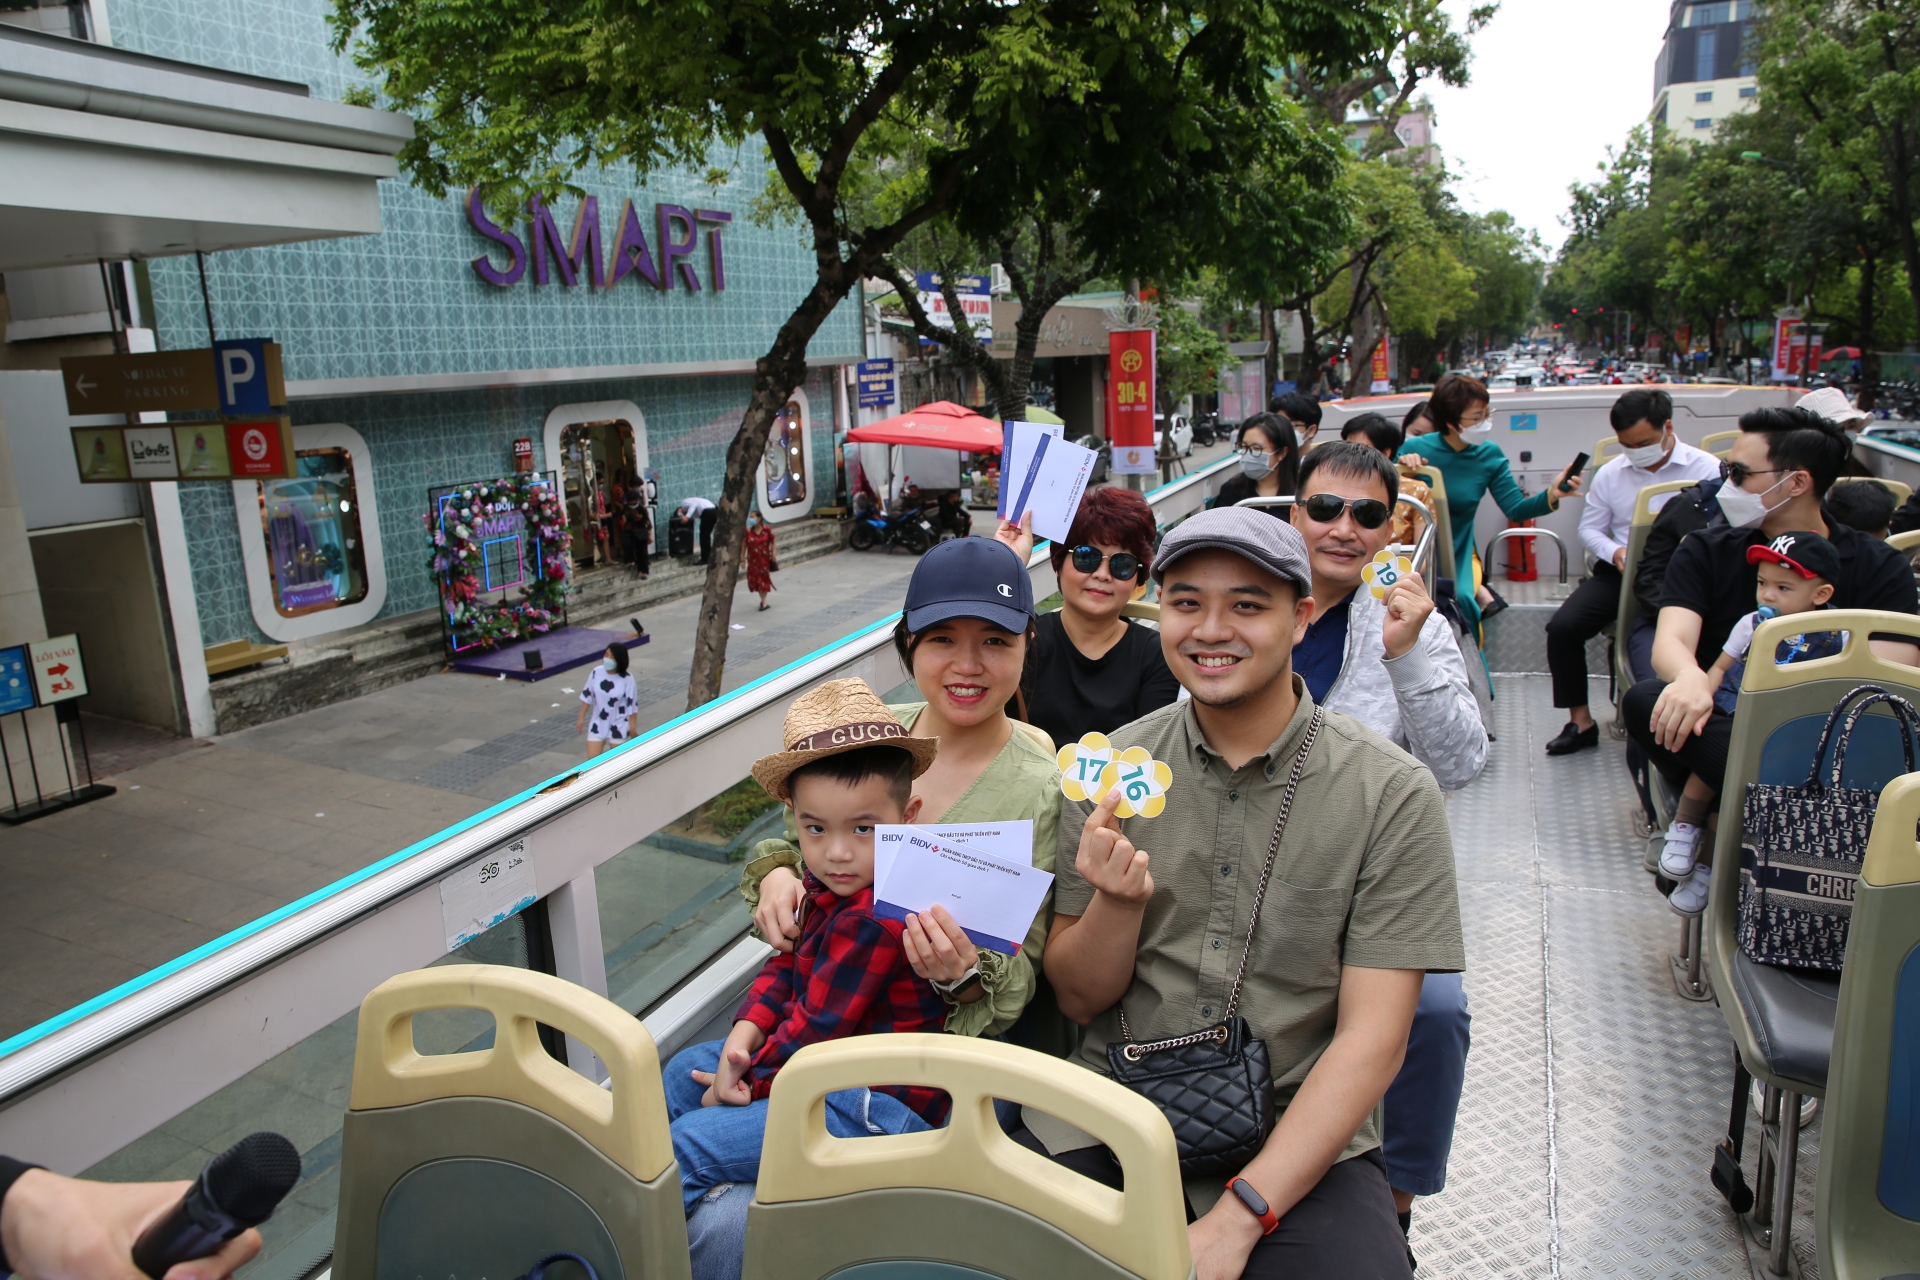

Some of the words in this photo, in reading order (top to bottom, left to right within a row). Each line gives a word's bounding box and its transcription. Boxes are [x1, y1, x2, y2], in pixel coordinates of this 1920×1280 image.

[465, 186, 732, 291] SMART
[221, 349, 254, 404] P
[124, 384, 190, 399] PARKING
[515, 442, 531, 452] 22B
[476, 514, 524, 538] SMART
[1769, 535, 1796, 555] NY
[55, 647, 75, 658] VÀO
[831, 725, 901, 744] GUCCI
[1077, 757, 1108, 783] 17
[1121, 765, 1151, 802] 16
[909, 836, 932, 850] BIDV
